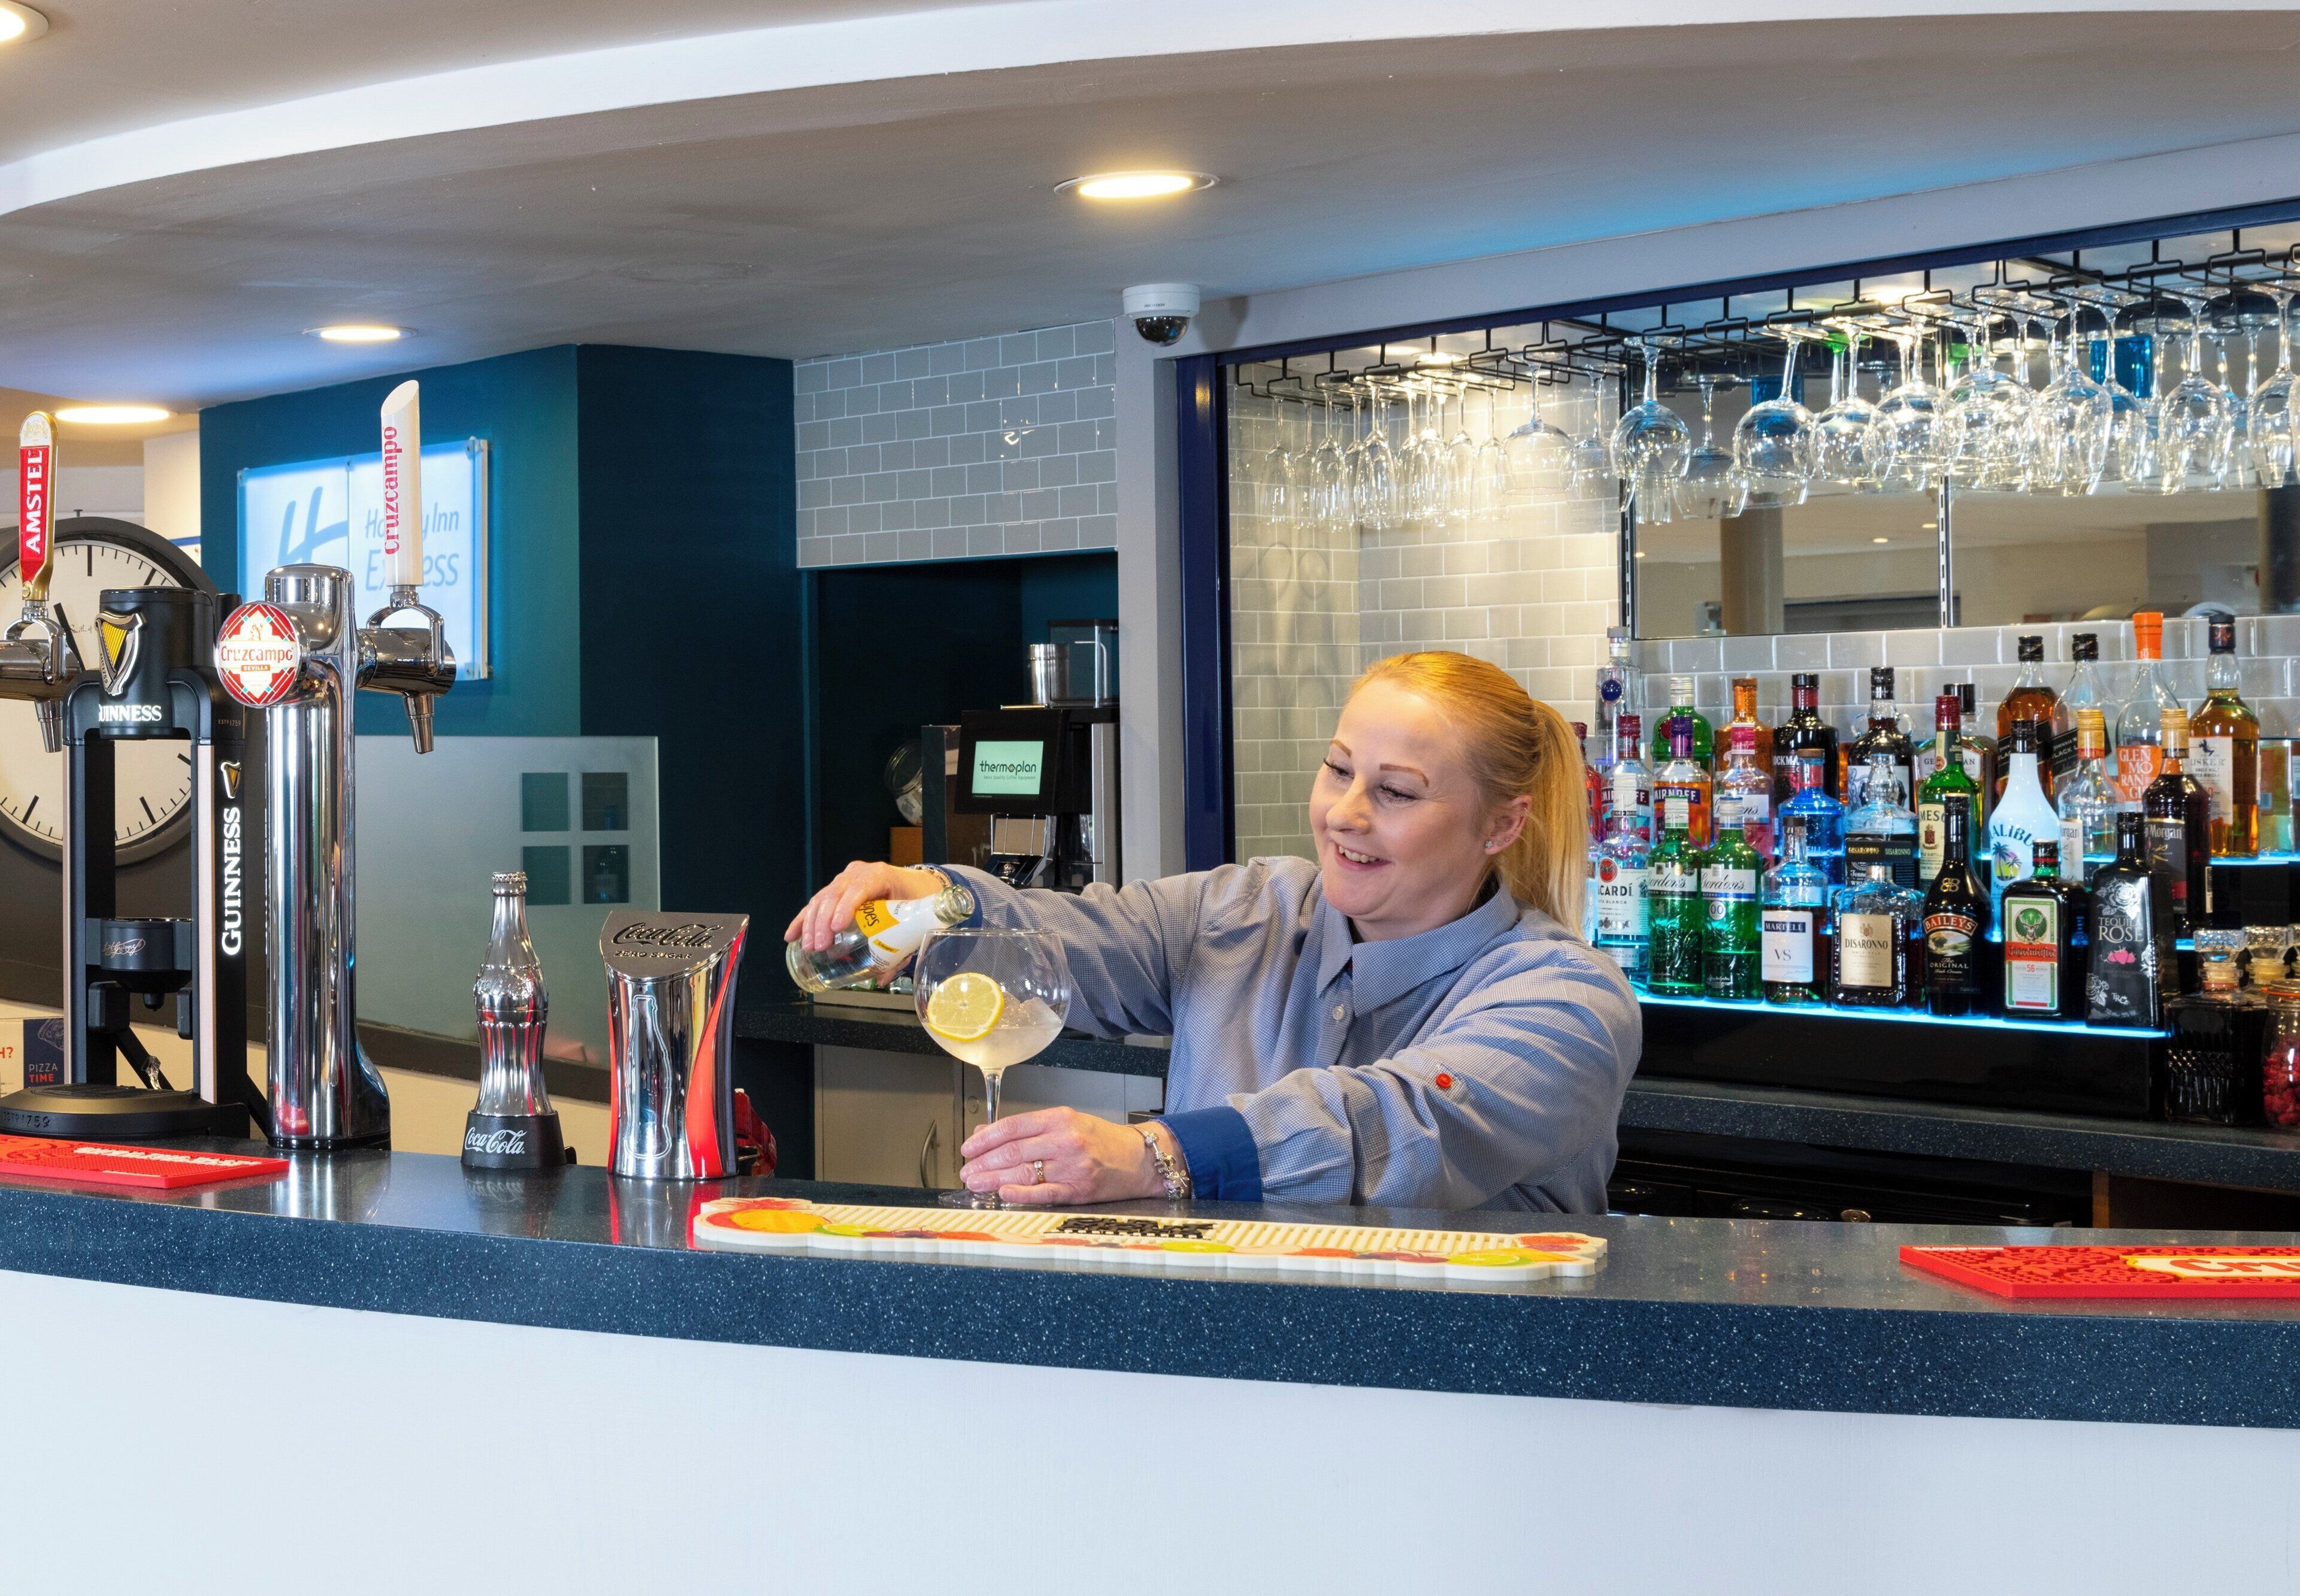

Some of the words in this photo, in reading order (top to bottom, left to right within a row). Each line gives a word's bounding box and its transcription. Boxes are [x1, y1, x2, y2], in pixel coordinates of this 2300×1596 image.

[384, 426, 402, 555] Cruzcampo
[26, 450, 43, 554] AMSTEL
[432, 502, 459, 533] Inn
[220, 645, 293, 664] Cruzcampo
[2119, 748, 2151, 762] GLEN
[979, 760, 1037, 776] thermoplan
[2129, 762, 2153, 774] MO
[2121, 774, 2144, 787] RAN
[2129, 787, 2143, 799] GI
[1990, 824, 2035, 847] ALIBU
[222, 807, 241, 955] GUINNESS
[1598, 882, 1633, 897] CARDÍ
[1765, 923, 1803, 931] MARTELL
[1925, 916, 1974, 930] BAILEYS
[2098, 917, 2143, 926] TEQUILA
[612, 922, 724, 947] Coca-Cola
[2098, 926, 2144, 944] ROSE
[1845, 938, 1888, 950] DISARONNO
[650, 951, 692, 959] SUGAR
[1774, 949, 1791, 961] VS
[2026, 964, 2035, 973] 56
[29, 1063, 58, 1072] PIZZA
[29, 1073, 54, 1083] TIME
[22, 1114, 51, 1128] 1759
[464, 1126, 527, 1155] Coca-Cola
